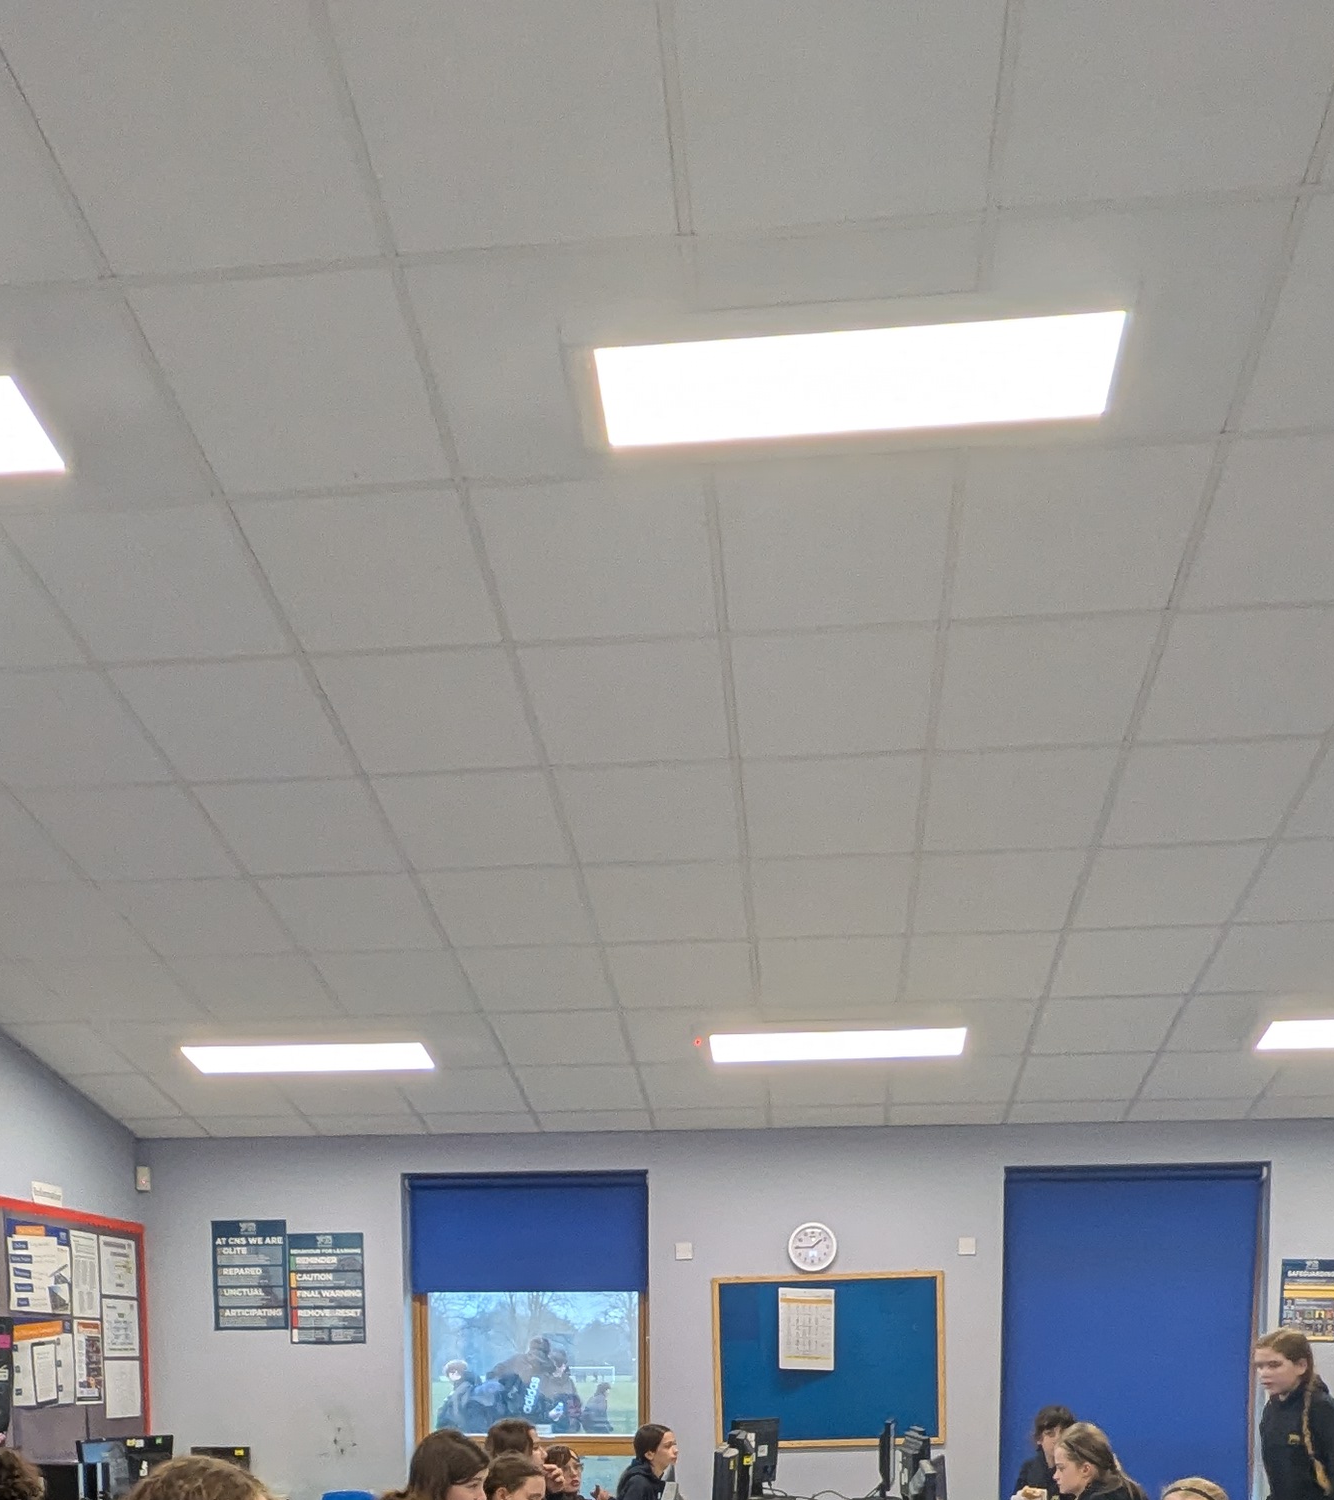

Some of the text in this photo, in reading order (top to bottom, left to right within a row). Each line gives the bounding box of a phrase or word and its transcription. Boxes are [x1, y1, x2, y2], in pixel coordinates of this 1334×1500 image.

[215, 1237, 227, 1245] AT
[248, 1237, 263, 1245] WE
[264, 1236, 283, 1245] ARE
[295, 1256, 337, 1264] REMINDER
[296, 1273, 333, 1281] CAUTION
[297, 1290, 362, 1298] FINAL WARNING
[523, 1376, 541, 1414] adidas
